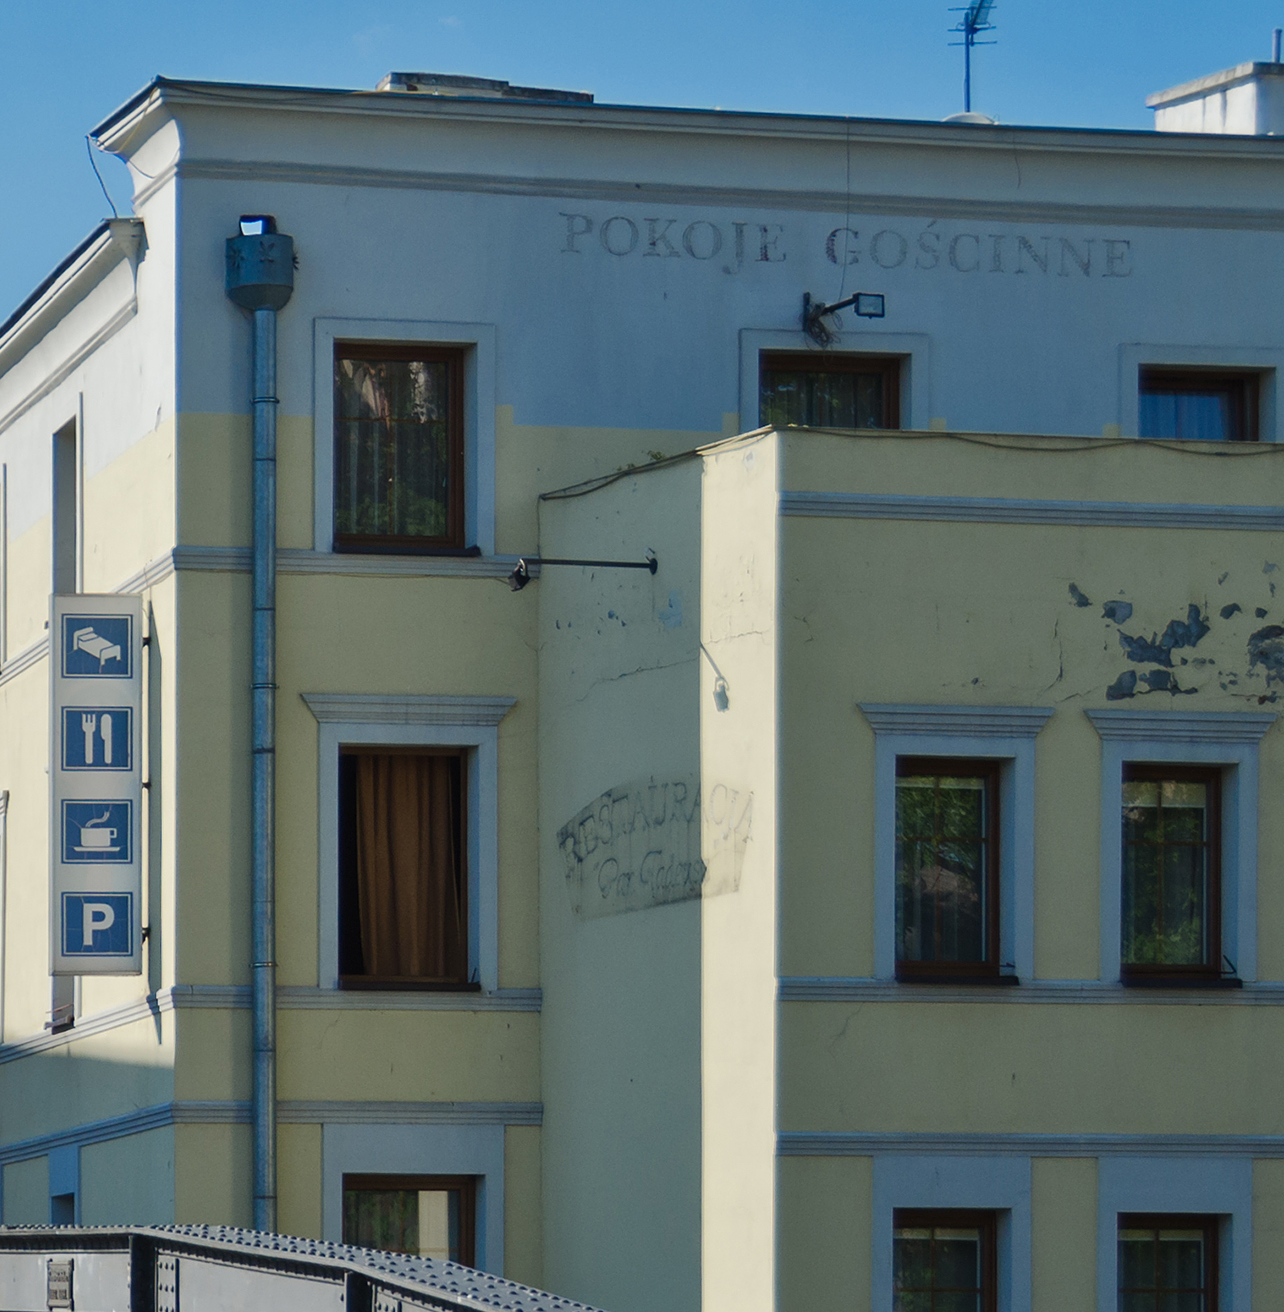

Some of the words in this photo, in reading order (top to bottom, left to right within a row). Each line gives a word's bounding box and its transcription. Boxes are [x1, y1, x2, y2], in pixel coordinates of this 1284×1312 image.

[558, 211, 788, 276] POKOJE
[824, 218, 1136, 279] GOŚCINNE
[82, 902, 115, 946] P
